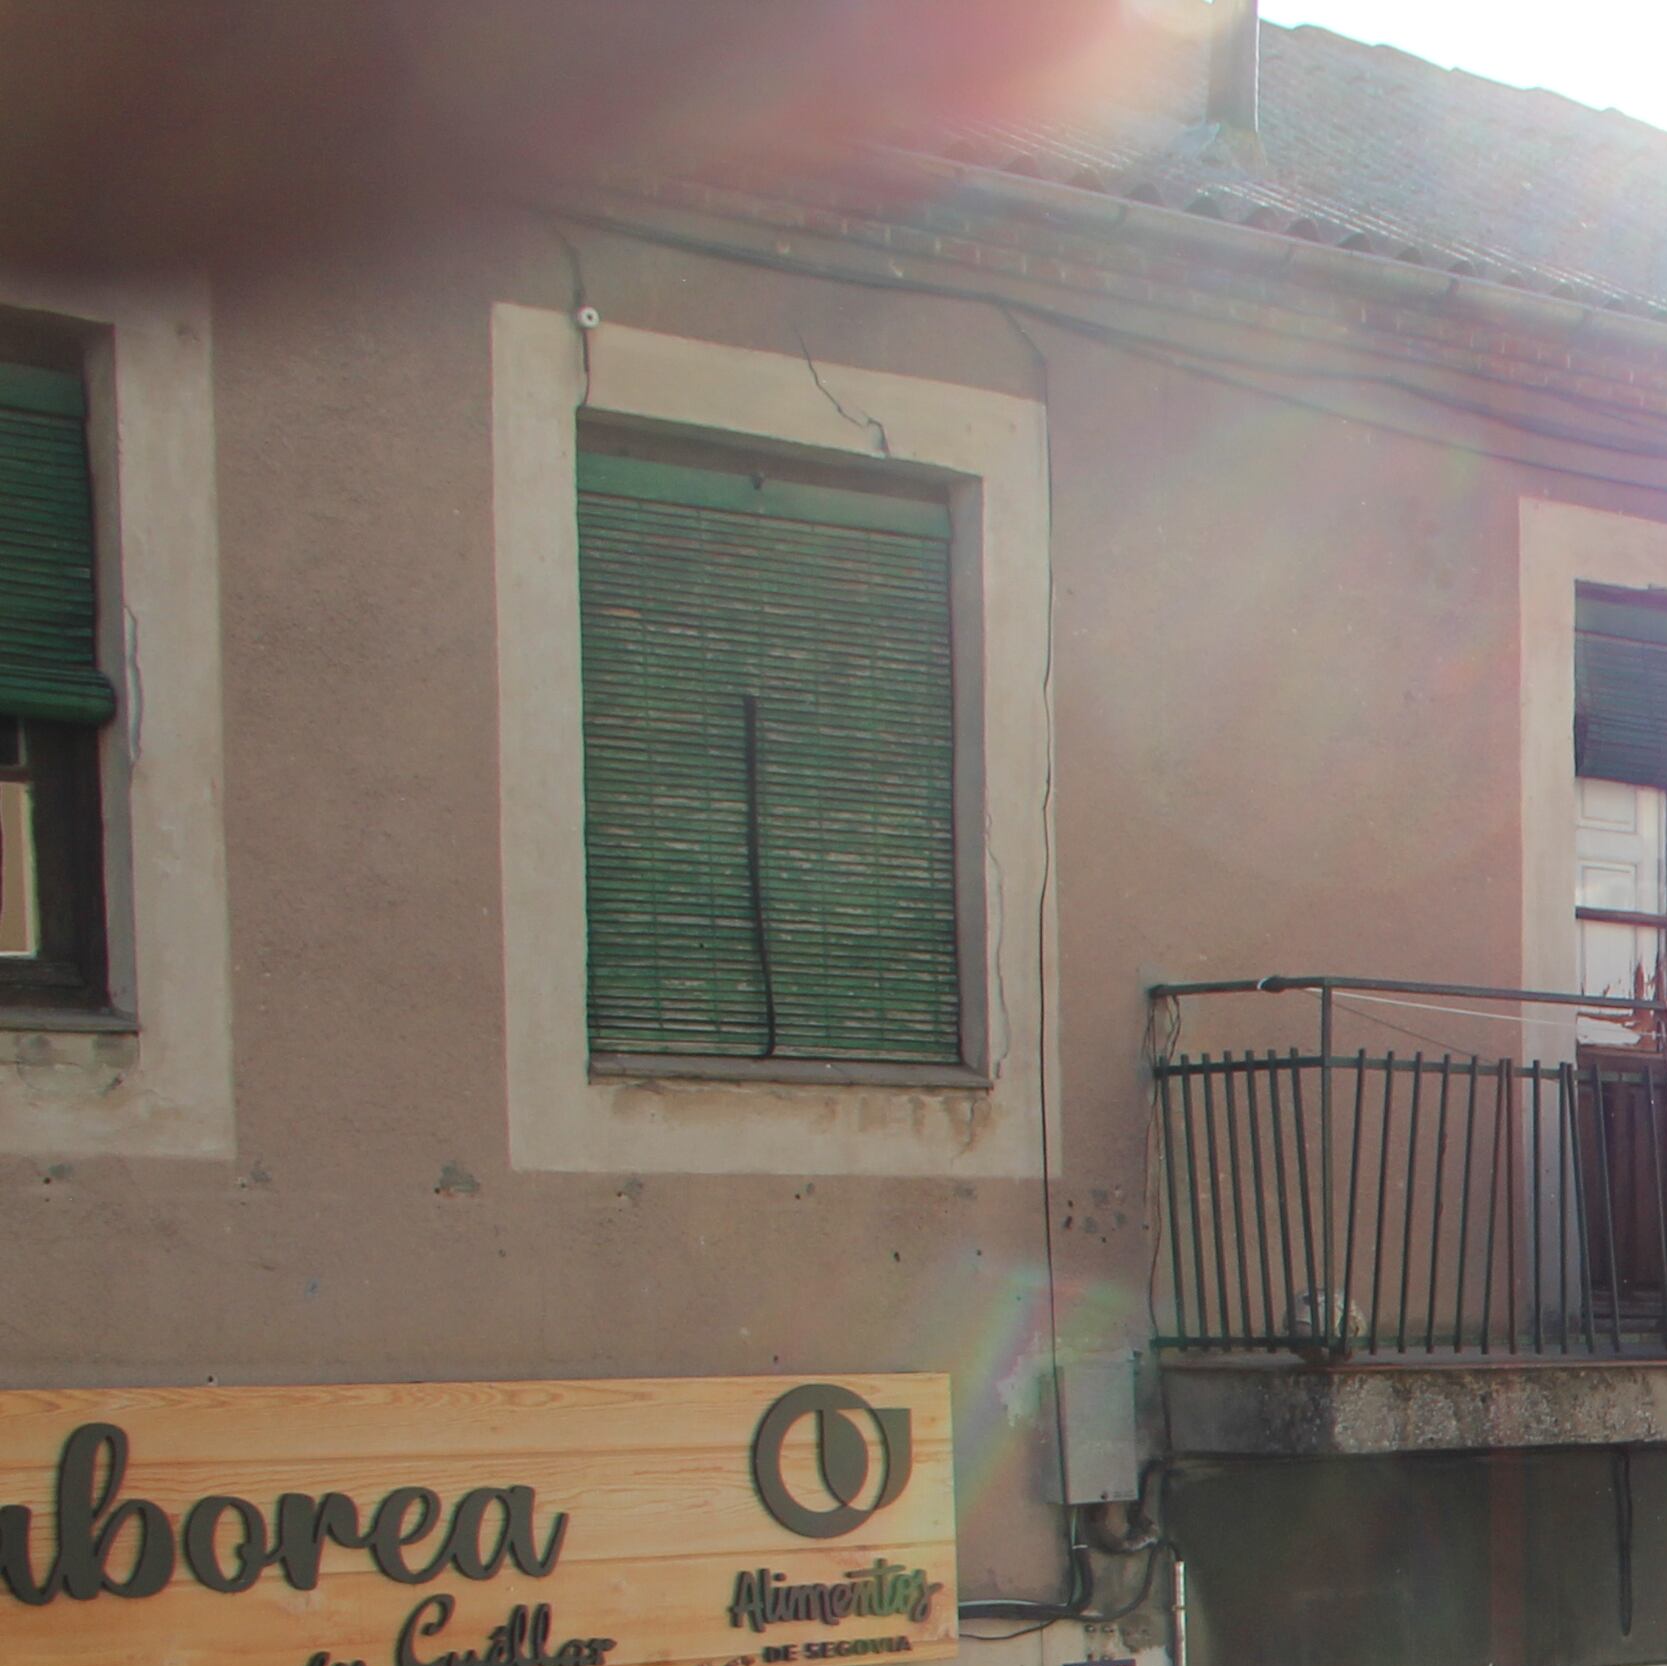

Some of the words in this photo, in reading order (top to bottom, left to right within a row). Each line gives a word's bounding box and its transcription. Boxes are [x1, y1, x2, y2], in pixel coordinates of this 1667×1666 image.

[727, 1557, 944, 1634] Alimentos
[763, 1643, 799, 1663] DE
[804, 1635, 913, 1660] SEGOVIA
